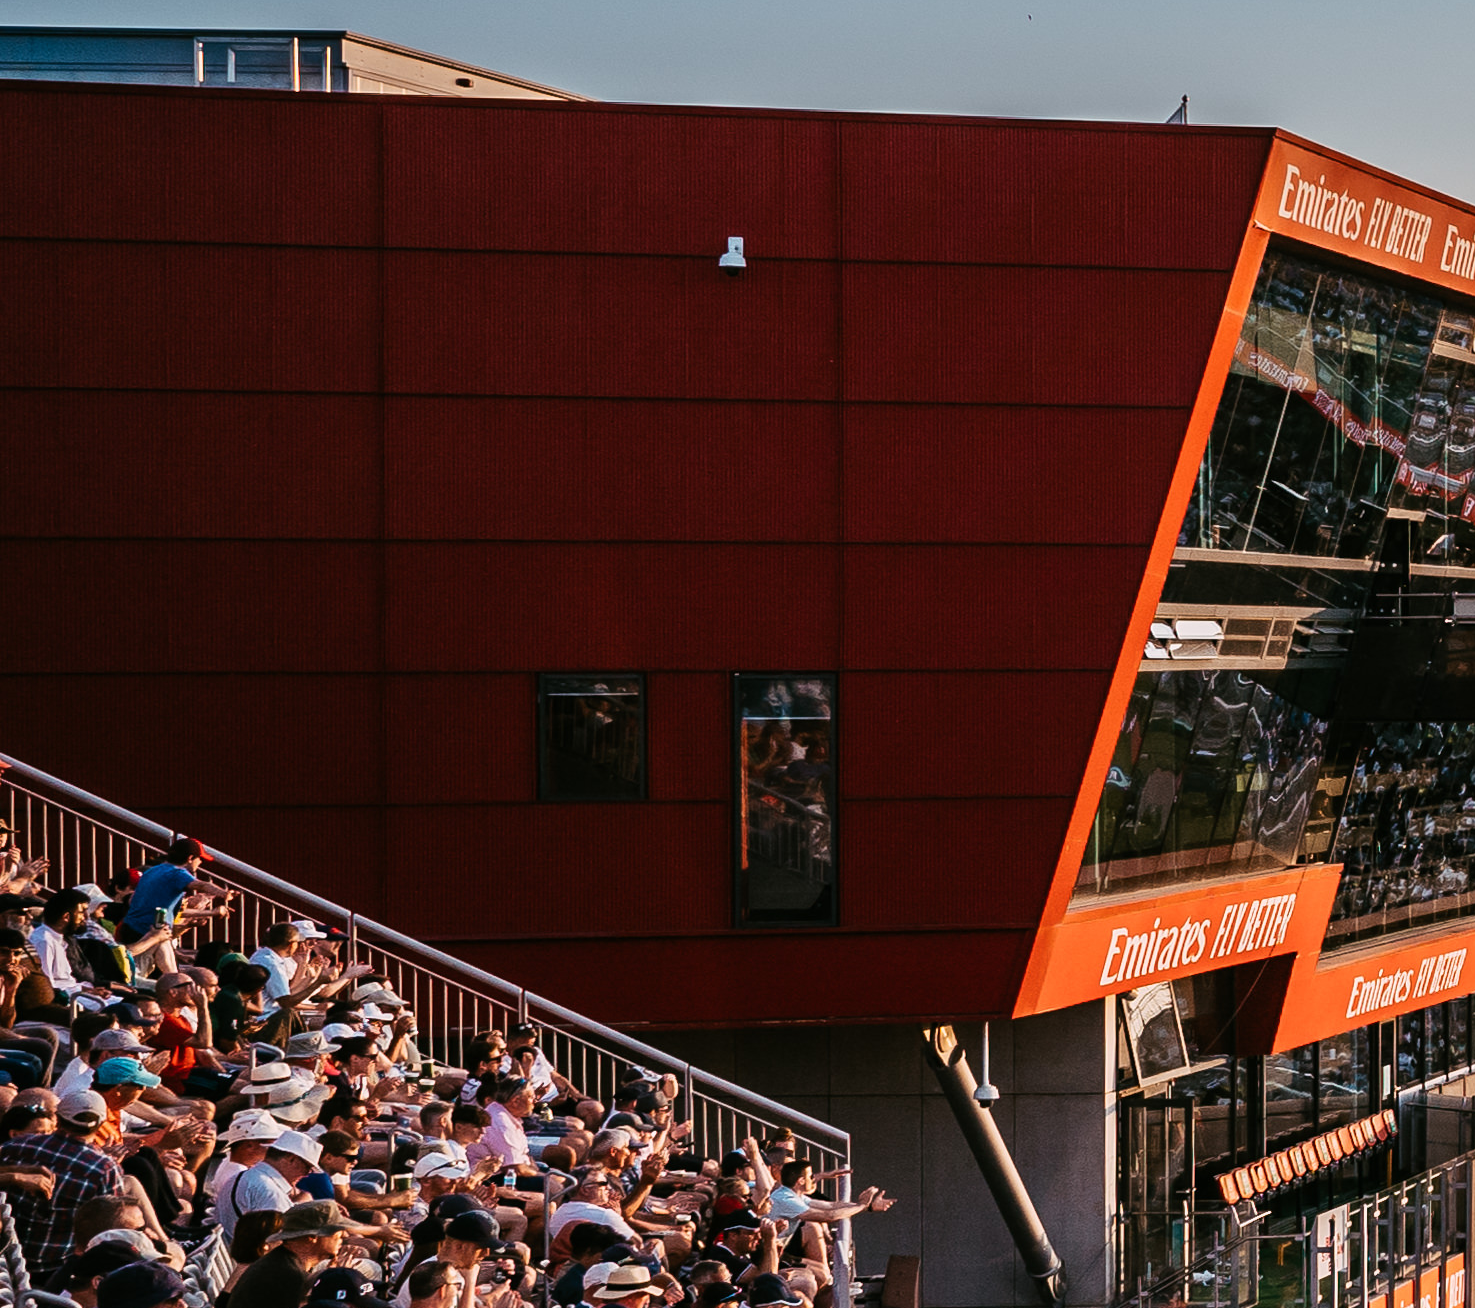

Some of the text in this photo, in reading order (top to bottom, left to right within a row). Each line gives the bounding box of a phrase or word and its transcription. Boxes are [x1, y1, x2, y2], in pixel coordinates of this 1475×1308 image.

[1278, 164, 1433, 264] Emirates FLY BETTER
[1100, 893, 1298, 987] Emirates FLY BETTER
[1346, 947, 1468, 1019] Emirates FLY BETTER
